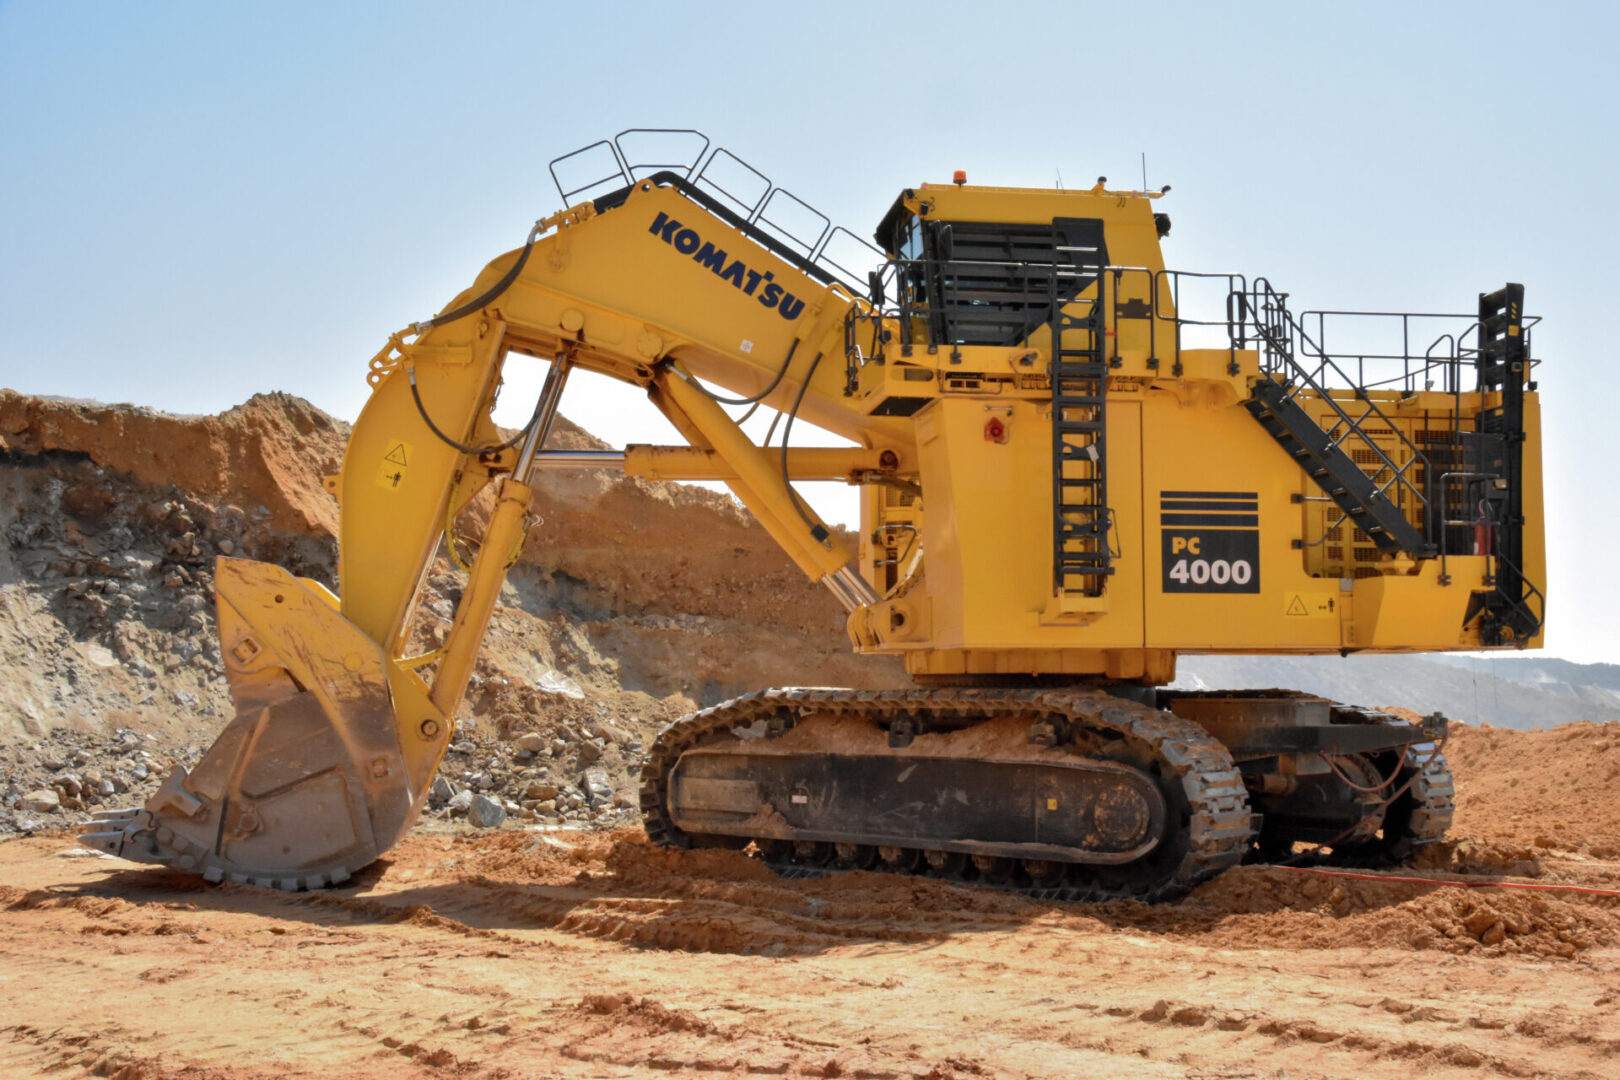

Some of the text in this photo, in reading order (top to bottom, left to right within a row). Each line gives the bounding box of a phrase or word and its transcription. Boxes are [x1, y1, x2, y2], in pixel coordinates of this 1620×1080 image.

[648, 211, 806, 320] KOMATSU
[1172, 537, 1200, 555] PC
[1169, 559, 1252, 585] 4000
